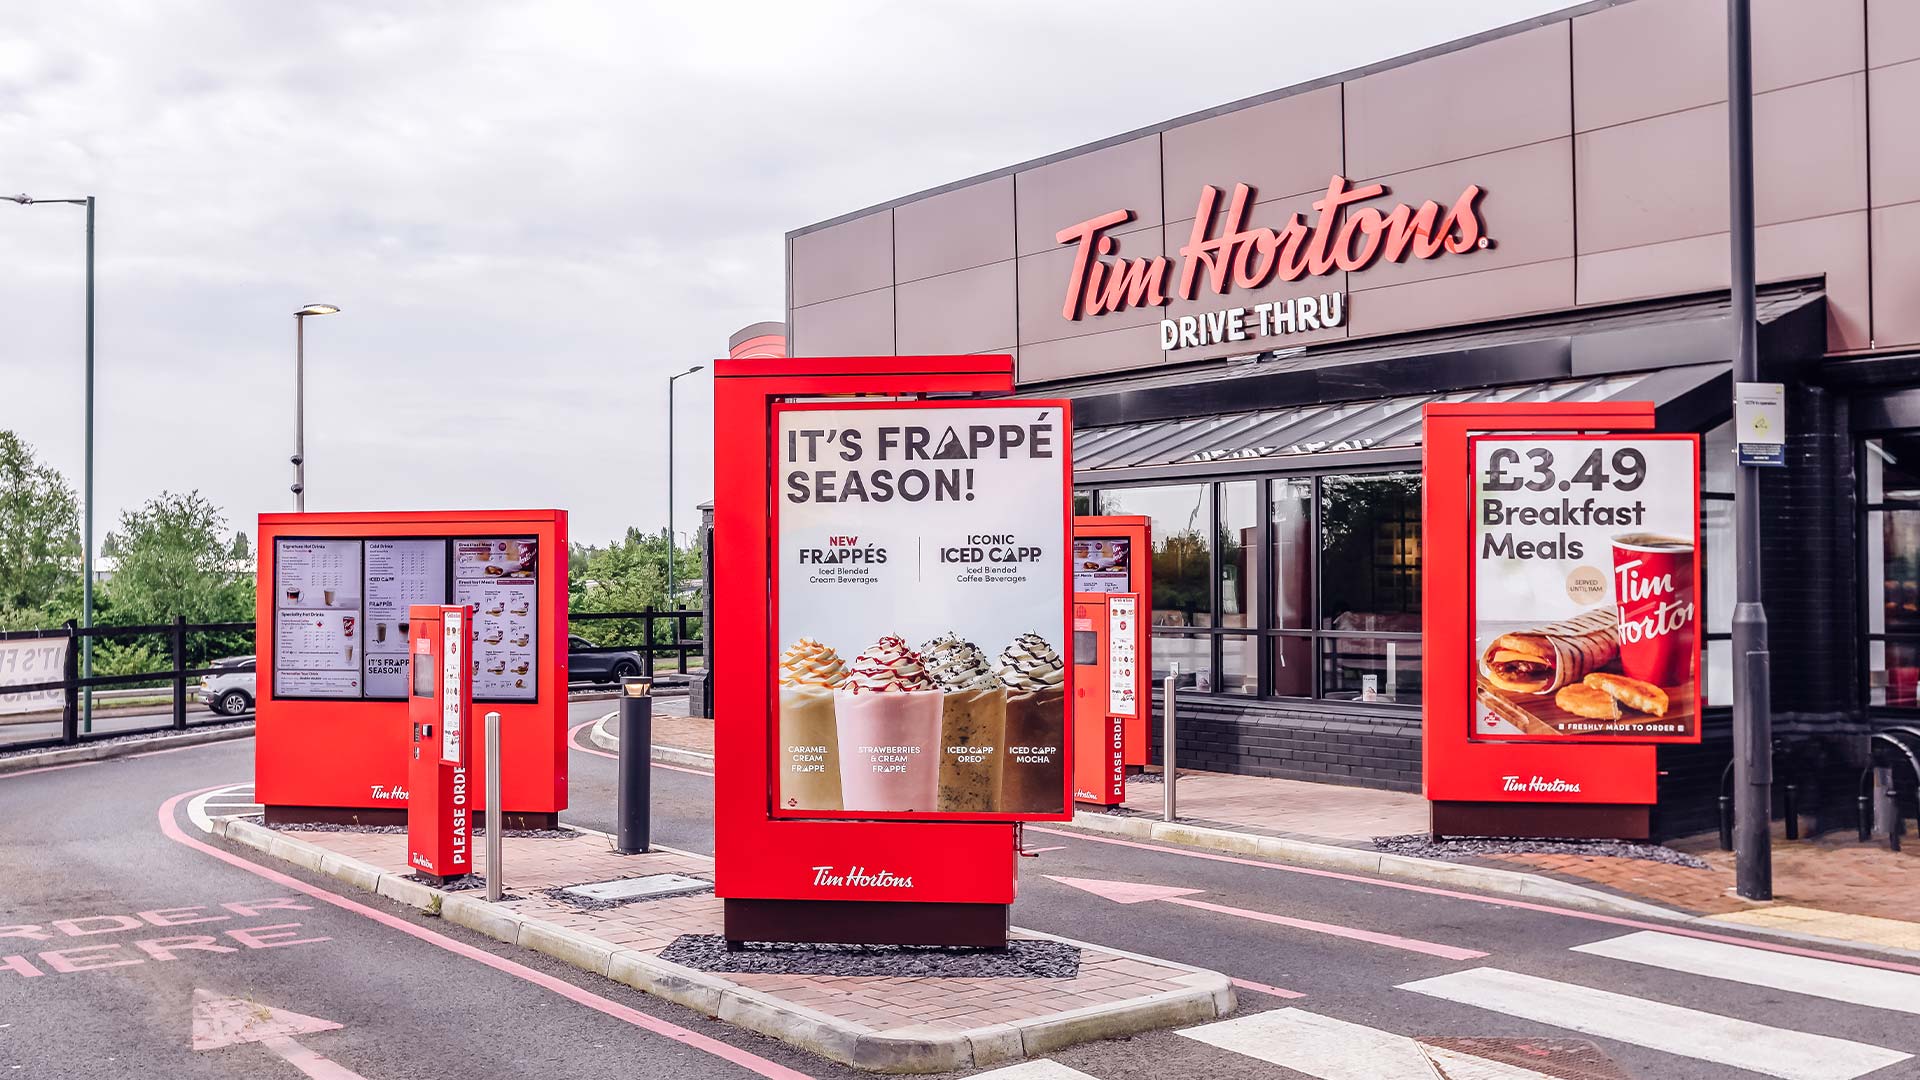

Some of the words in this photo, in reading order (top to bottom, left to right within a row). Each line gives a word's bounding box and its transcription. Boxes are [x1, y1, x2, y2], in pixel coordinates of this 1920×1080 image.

[1056, 209, 1166, 321] Tim
[1178, 175, 1480, 299] Hortons
[1160, 307, 1246, 351] DRIVE
[1255, 291, 1345, 337] THRU
[878, 411, 1053, 461] FRAPPÉ
[1482, 447, 1647, 492] £3.49
[787, 468, 976, 504] SEASON!
[1482, 498, 1646, 526] Breakfast
[829, 536, 858, 546] NEW
[968, 535, 1015, 545] ICONIC
[1482, 532, 1584, 560] Meals
[799, 543, 887, 564] FRAPPÉS
[941, 547, 984, 563] ICED
[819, 567, 835, 575] Iced
[837, 567, 869, 575] Blended
[966, 566, 982, 574] Iced
[985, 566, 1017, 574] Blended
[809, 576, 836, 584] Cream
[838, 576, 878, 585] Beverages
[957, 575, 983, 583] Coffee
[985, 575, 1027, 584] Beverages
[1615, 559, 1674, 604] Tim
[1567, 723, 1603, 731] FRESHLY
[1646, 724, 1675, 732] ORDER
[858, 746, 921, 754] STRAWBERRIES
[947, 746, 967, 754] ICED
[1009, 746, 1029, 754] ICED
[793, 754, 823, 762] CREAM
[1016, 755, 1050, 763] MOCHA
[791, 763, 825, 773] FRAPPÉ
[872, 763, 907, 773] FRAPPÉ
[1113, 752, 1122, 795] PLEASE
[1502, 776, 1527, 792] Tim
[1528, 775, 1581, 793] Hortons
[370, 785, 390, 799] Tim
[453, 808, 466, 864] PLEASE
[812, 866, 843, 887] Tim
[846, 866, 914, 888] Hortons
